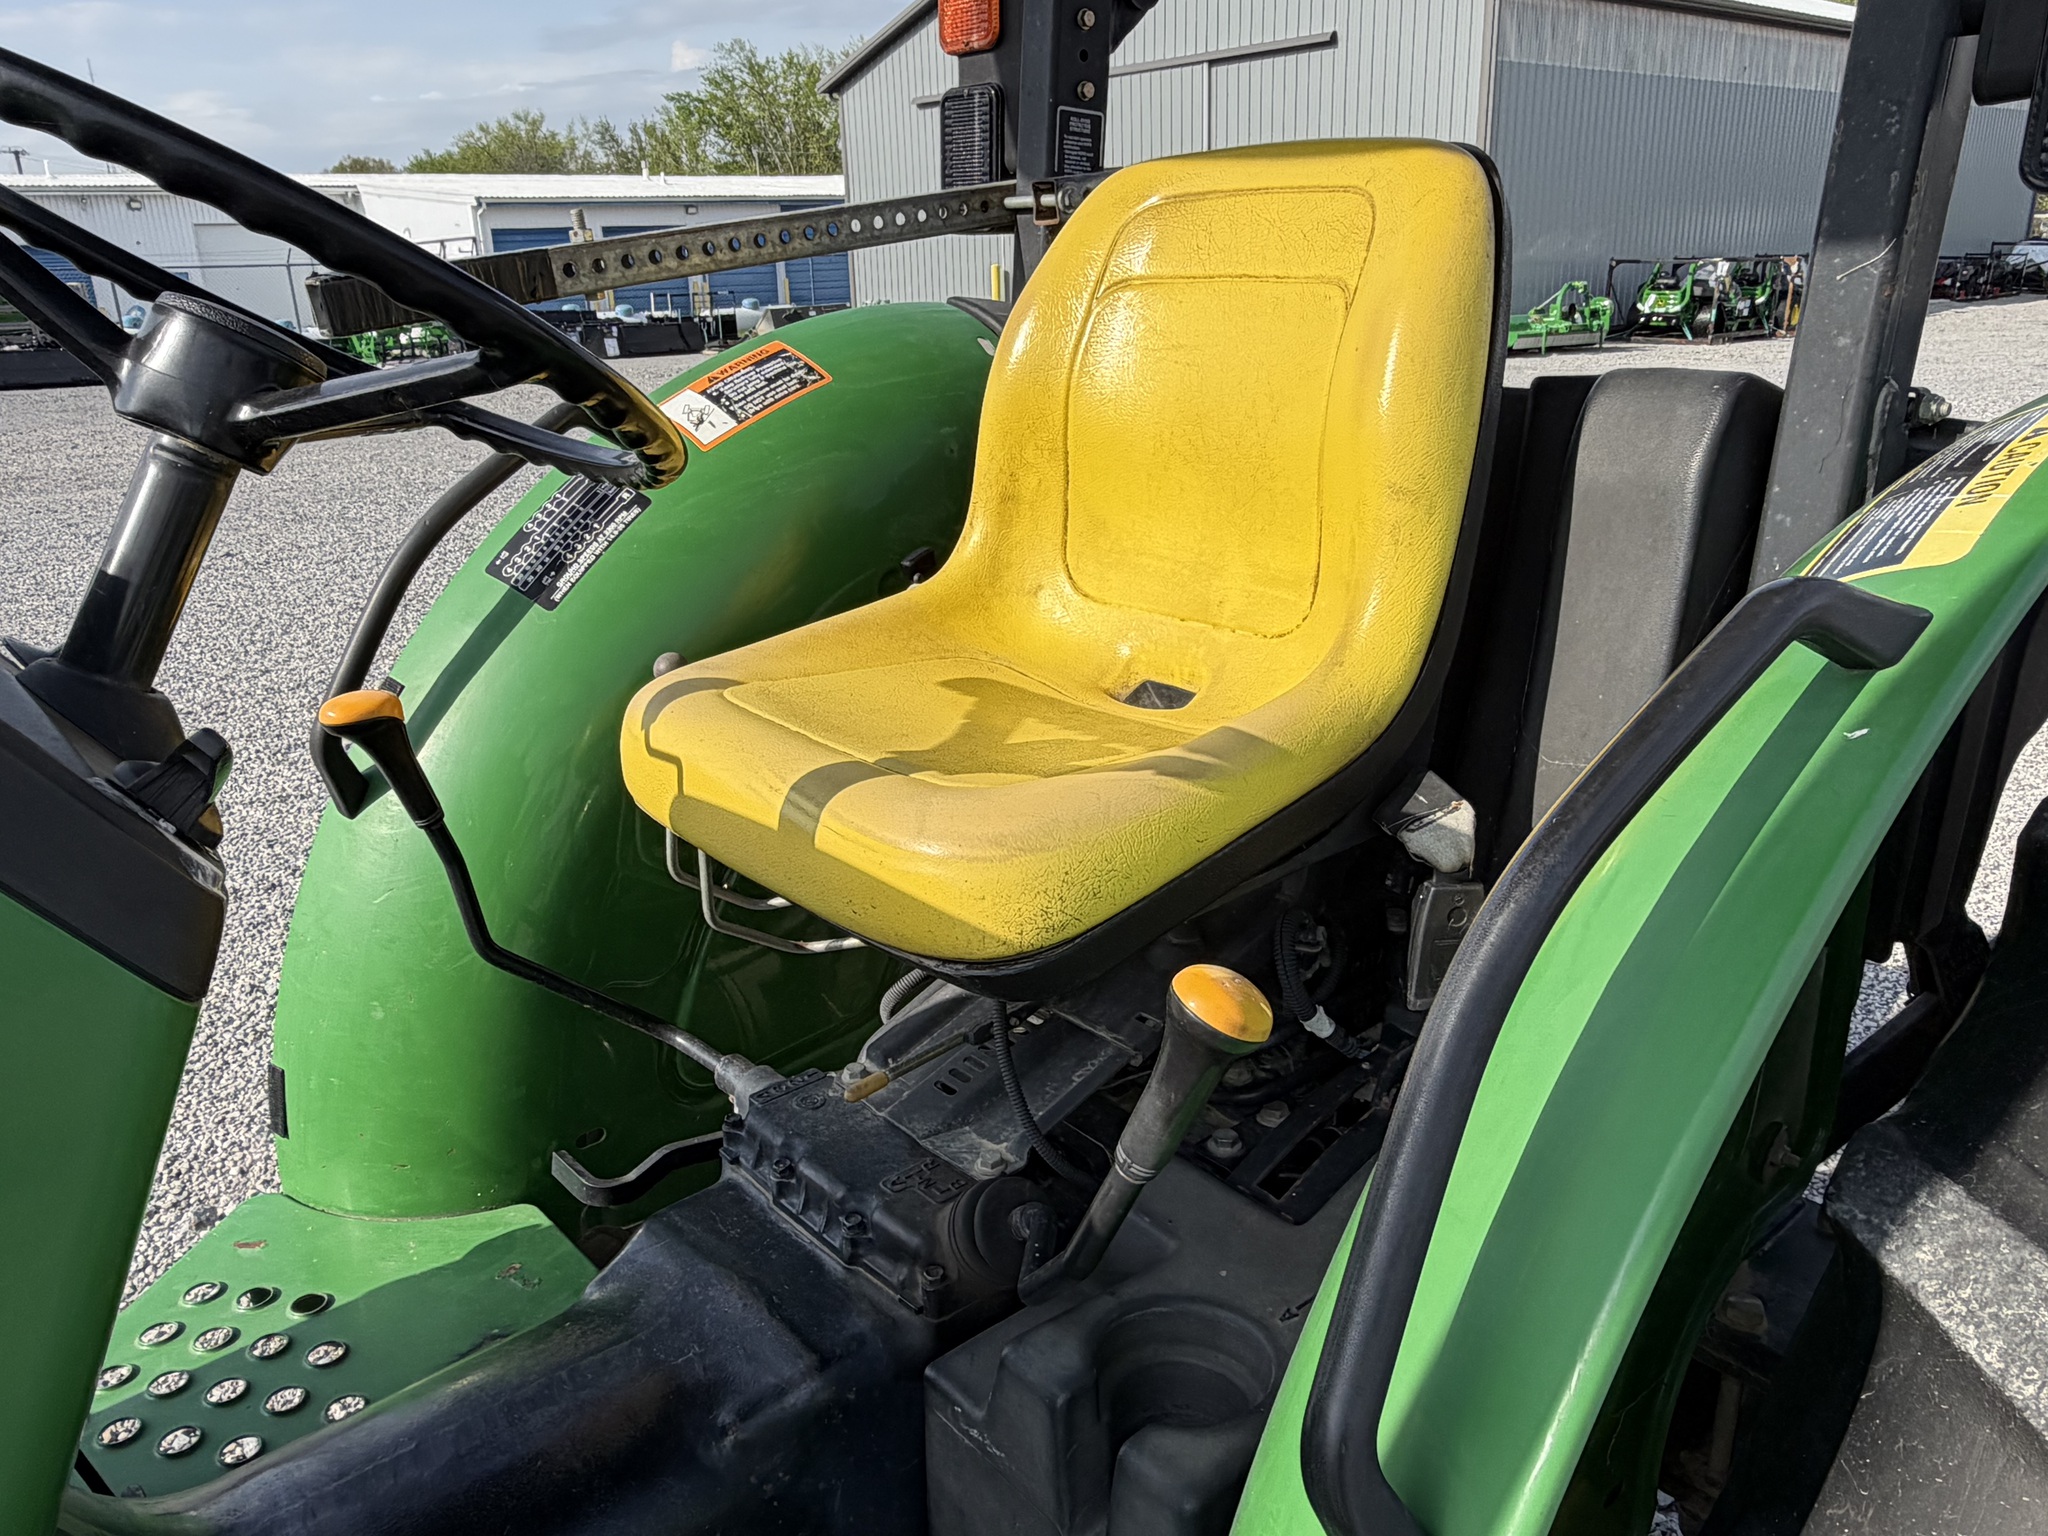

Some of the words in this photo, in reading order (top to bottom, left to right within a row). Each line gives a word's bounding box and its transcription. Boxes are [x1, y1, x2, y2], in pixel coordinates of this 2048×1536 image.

[718, 348, 770, 377] WARNING
[753, 395, 765, 405] NOT
[1955, 441, 2041, 508] CAUTION
[555, 581, 571, 603] (WHEN
[571, 554, 596, 583] EQUIPPED
[596, 540, 608, 555] WITH
[556, 563, 579, 588] GROUND
[577, 541, 599, 564] SPEEDS
